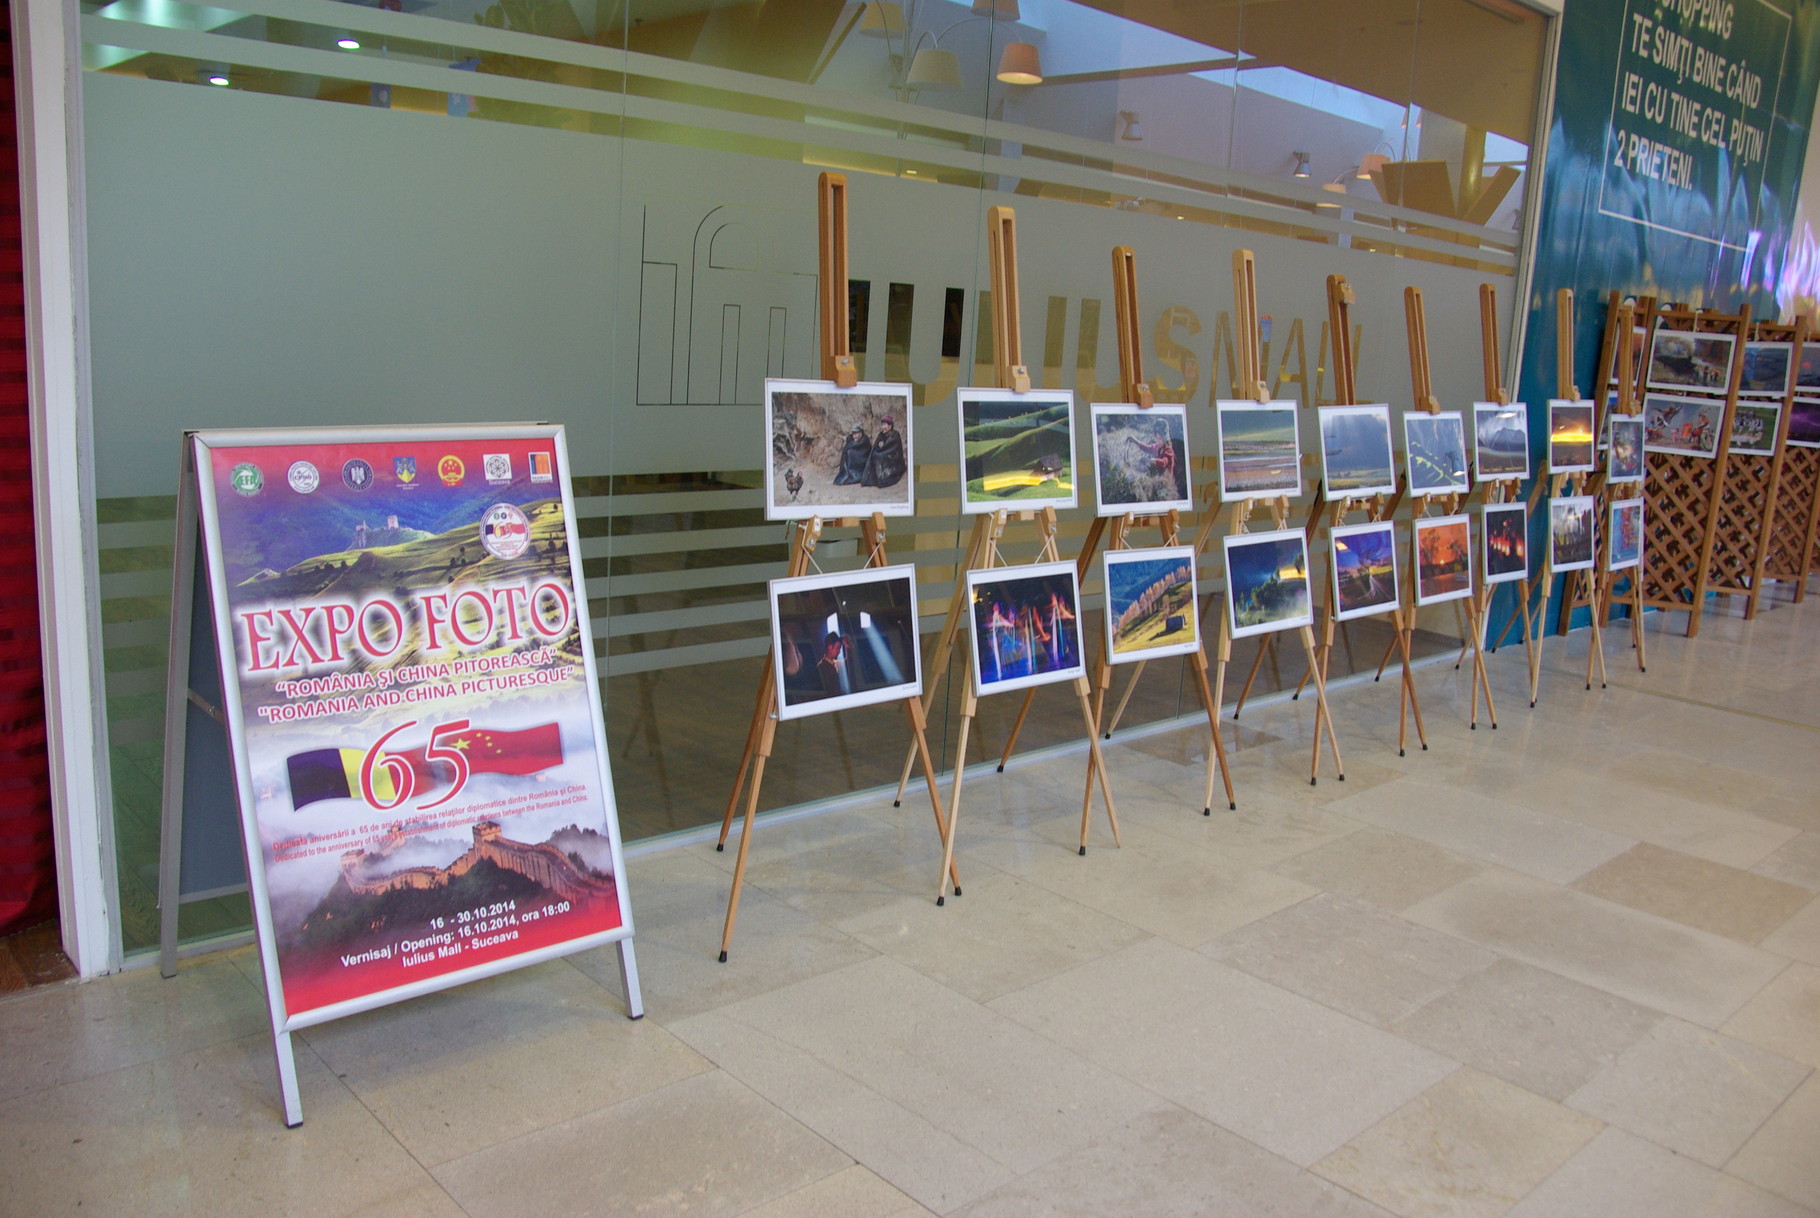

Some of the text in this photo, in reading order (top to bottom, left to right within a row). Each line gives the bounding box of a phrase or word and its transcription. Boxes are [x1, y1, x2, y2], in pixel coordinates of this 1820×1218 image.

[1661, 0, 1734, 39] OPPING
[1632, 13, 1653, 58] TE
[1692, 45, 1727, 93] BINE
[1726, 59, 1762, 109] CÂND
[1621, 71, 1643, 115] IEI
[1644, 81, 1668, 124] CU
[1670, 92, 1701, 138] TINE
[1701, 107, 1726, 148] CEL
[1613, 129, 1693, 190] 2 PRIETENI.
[241, 583, 570, 672] EXPO FOTO
[258, 697, 358, 723] "ROMANIA
[362, 691, 402, 710] AND
[405, 684, 457, 704] CHINA
[399, 665, 450, 683] CHINA
[359, 719, 470, 811] 65
[274, 851, 308, 863] Dedicated
[308, 848, 315, 856] to
[316, 846, 326, 855] the
[327, 840, 363, 853] anniversary
[364, 836, 371, 845] of
[372, 834, 380, 843] 65
[439, 820, 446, 829] of
[447, 815, 479, 829] diplomatic
[502, 806, 526, 818] between
[526, 803, 536, 813] the
[535, 799, 561, 811] Romania
[561, 797, 571, 806] and
[359, 824, 369, 834] 65
[370, 823, 380, 832] de
[381, 820, 392, 830] ani
[393, 818, 403, 829] de
[404, 812, 437, 825] stabilirea
[466, 799, 506, 814] diplomatice
[507, 795, 527, 807] dintre
[528, 788, 558, 801] România
[341, 945, 392, 968] Vernisaj
[401, 930, 455, 953] Opening:
[457, 914, 520, 938] 16.10.2014,
[522, 911, 540, 923] ora
[541, 900, 571, 916] 18:00
[429, 917, 444, 931] 16
[457, 899, 516, 925] 30.10.2014
[402, 951, 435, 968] Iulius
[438, 942, 462, 959] Mall
[471, 930, 519, 950] Suceava
